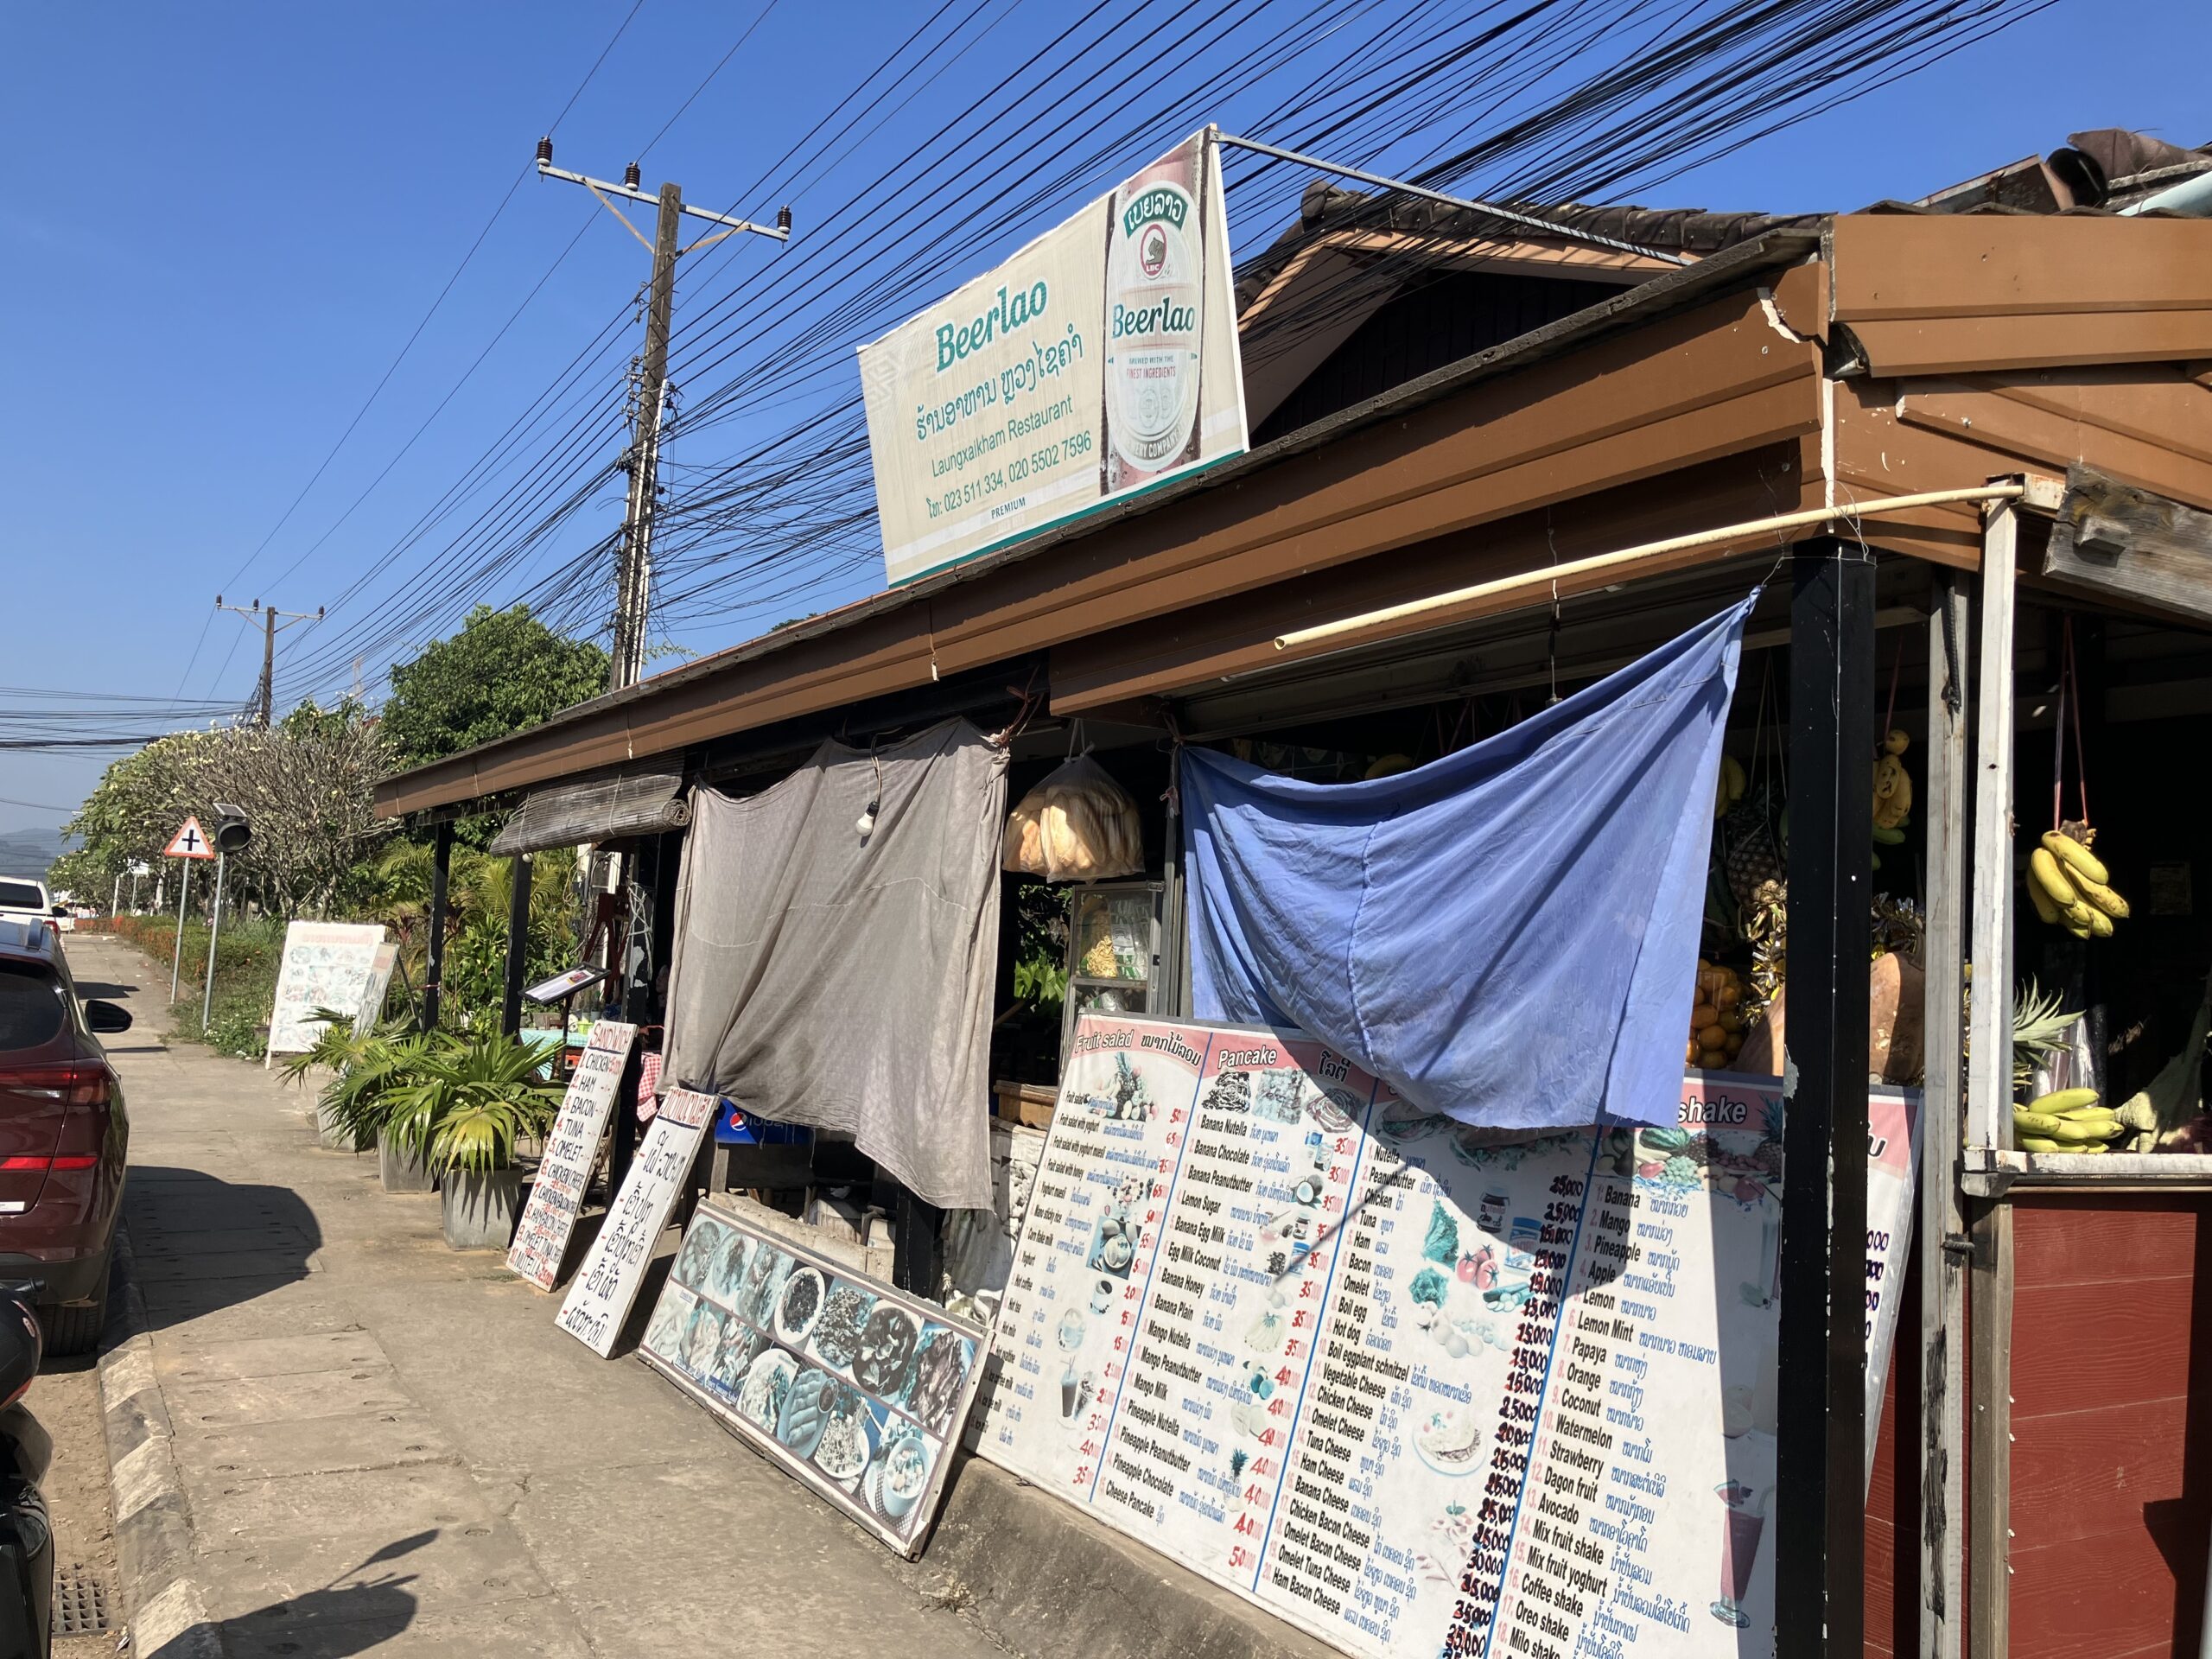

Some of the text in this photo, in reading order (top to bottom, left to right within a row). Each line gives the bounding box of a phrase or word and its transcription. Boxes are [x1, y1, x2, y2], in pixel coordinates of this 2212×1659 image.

[1128, 193, 1183, 230] ເບຍລາວ
[937, 282, 1047, 372] Beerlao
[1112, 297, 1195, 339] Beerlao
[1127, 366, 1176, 379] FINEST INGREDIENTS
[931, 394, 1073, 477] Laungxaikham Restaurant
[1148, 437, 1179, 458] COMPANY
[944, 489, 963, 512] 023
[964, 480, 982, 504] 511
[1008, 458, 1029, 483] 020
[1032, 445, 1059, 474] 5502
[1062, 430, 1092, 461] 7596
[991, 497, 1026, 518] PREMIUM
[589, 1022, 632, 1052] SANDWICH
[1074, 1031, 1102, 1053] Fruit
[1102, 1029, 1135, 1049] salad
[1217, 1045, 1277, 1069] Pancake
[578, 1076, 597, 1093] HAM
[570, 1096, 597, 1118] BACON
[1677, 1095, 1747, 1124] shake
[563, 1119, 584, 1139] TUNA
[1200, 1115, 1247, 1136] Banana Nutella
[1194, 1140, 1249, 1165] Banana Chocolate
[1374, 1145, 1400, 1164] Nutella
[1187, 1165, 1253, 1193] Banana Peanutbutter
[1369, 1166, 1415, 1191] Peanutbutter
[1181, 1191, 1221, 1216] Lemon Sugar
[1364, 1188, 1393, 1208] Chicken
[1605, 1185, 1641, 1208] Banana
[1174, 1217, 1225, 1244] Banana Egg Milk
[1359, 1210, 1376, 1228] Tuna
[1599, 1210, 1630, 1236] Mango
[1354, 1230, 1370, 1249] Ham
[1593, 1235, 1641, 1264] Pineapple
[1168, 1242, 1221, 1271] Egg Milk Coconut
[1349, 1253, 1371, 1273] Bacon
[1161, 1268, 1205, 1299] Banana Honey
[1344, 1274, 1370, 1296] Omelet
[1587, 1261, 1616, 1285] Apple
[1154, 1294, 1193, 1321] Banana Plain
[1338, 1297, 1367, 1324] Boil egg
[1583, 1285, 1615, 1310] Lemon
[1147, 1320, 1191, 1350] Mango Nutella
[1333, 1319, 1346, 1334] Hot
[1346, 1324, 1361, 1345] dog
[1577, 1311, 1634, 1343] Lemon Mint
[1141, 1346, 1202, 1384] Mango Peanutbutter
[1327, 1340, 1343, 1359] Boil
[1343, 1349, 1375, 1374] eggplant
[1376, 1359, 1409, 1382] schnitzel
[1572, 1336, 1607, 1366] Papaya
[1134, 1373, 1168, 1402] Mango Milk
[1323, 1363, 1386, 1399] Vegetable Cheese
[1567, 1363, 1601, 1392] Orange
[1317, 1385, 1373, 1420] Chicken Cheese
[1561, 1388, 1601, 1417] Coconut
[1127, 1400, 1179, 1437] Pineapple Nutella
[1312, 1408, 1364, 1442] Omelet Cheese
[1555, 1413, 1612, 1450] Watermelon
[1120, 1427, 1192, 1473] Pineapple Peanutbutter
[1306, 1430, 1351, 1462] Tuna Cheese
[1550, 1440, 1605, 1480] Strawberry
[1112, 1453, 1174, 1497] Pineapple Chocolate
[1300, 1452, 1344, 1484] Ham Cheese
[1294, 1475, 1321, 1501] Banana
[1322, 1486, 1349, 1513] Cheese
[1544, 1466, 1599, 1503] Dagon fruit
[1105, 1480, 1154, 1519] Cheese Pancake
[1537, 1492, 1580, 1525] Avocado
[1289, 1498, 1318, 1524] Chicken
[1318, 1510, 1341, 1535] Bacon
[1342, 1521, 1370, 1548] Cheese
[1283, 1522, 1361, 1572] Omelet Bacon Cheese
[1532, 1519, 1604, 1565] Mix fruit shake
[1278, 1544, 1351, 1593] Omelet Tuna Cheese
[1527, 1545, 1607, 1598] Mix fruit yoghurt
[1272, 1567, 1340, 1615] Ham Bacon Cheese
[1521, 1573, 1583, 1618] Coffee shake
[1516, 1599, 1569, 1642] Oreo shake
[1509, 1627, 1529, 1654] Milo
